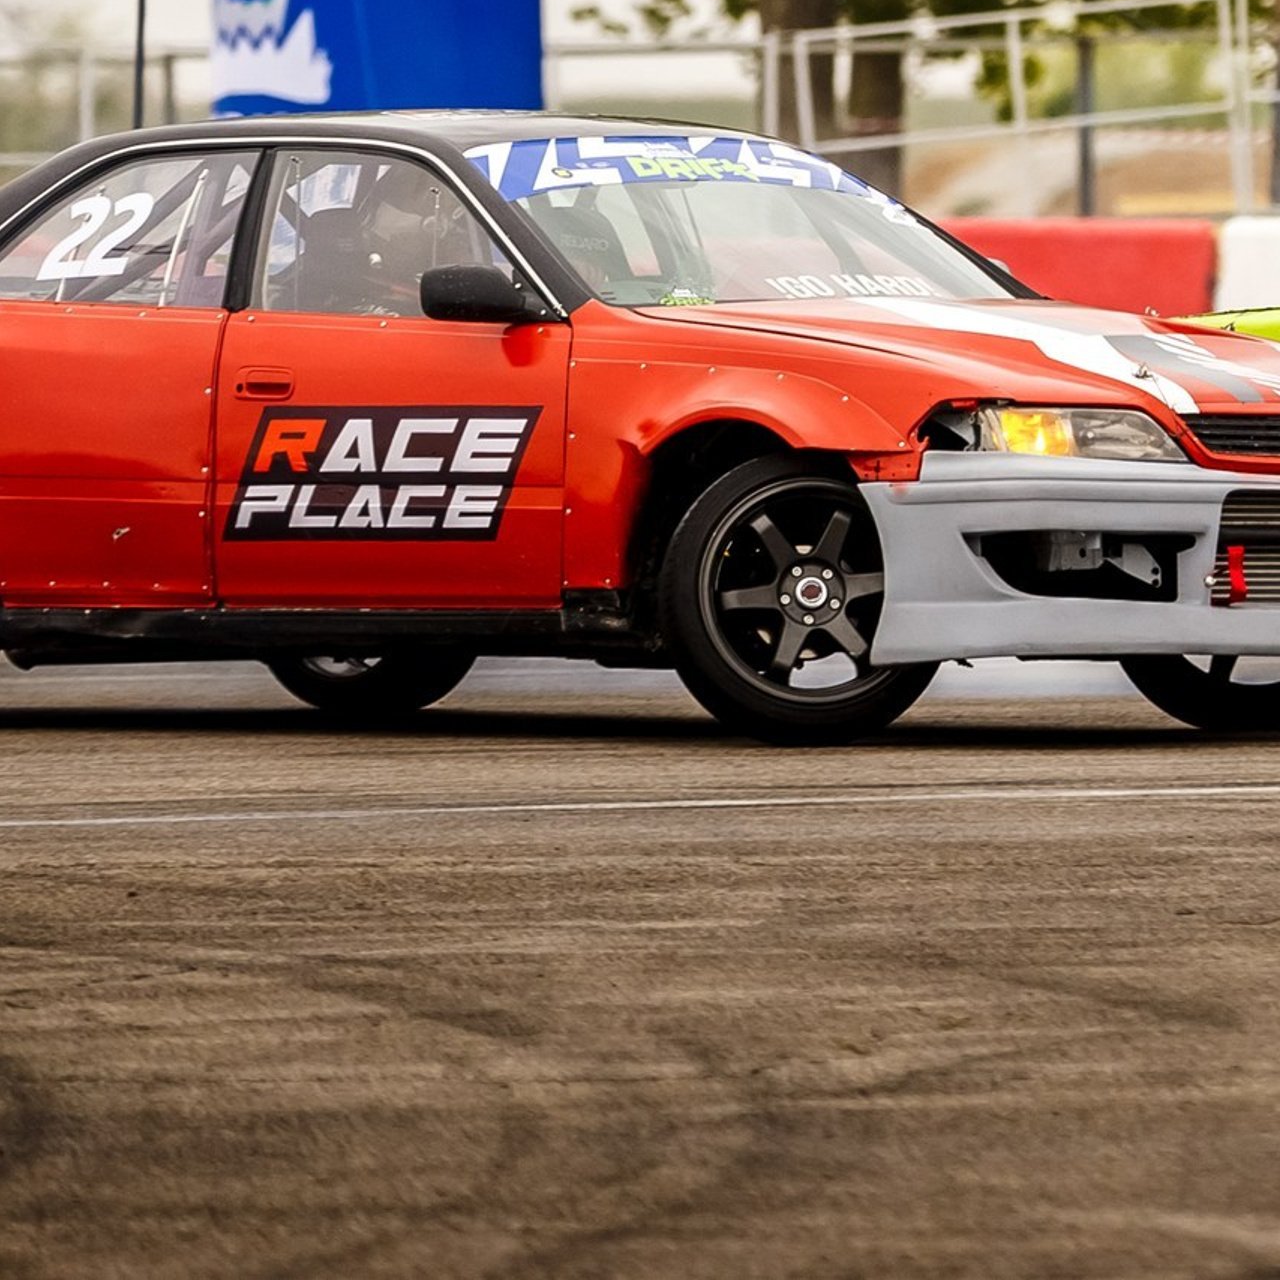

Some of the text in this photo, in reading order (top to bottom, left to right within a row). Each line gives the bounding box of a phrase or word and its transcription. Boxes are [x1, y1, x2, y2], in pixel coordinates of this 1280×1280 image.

[37, 193, 154, 280] 22
[253, 418, 528, 473] RACE
[234, 485, 503, 528] PLACE
